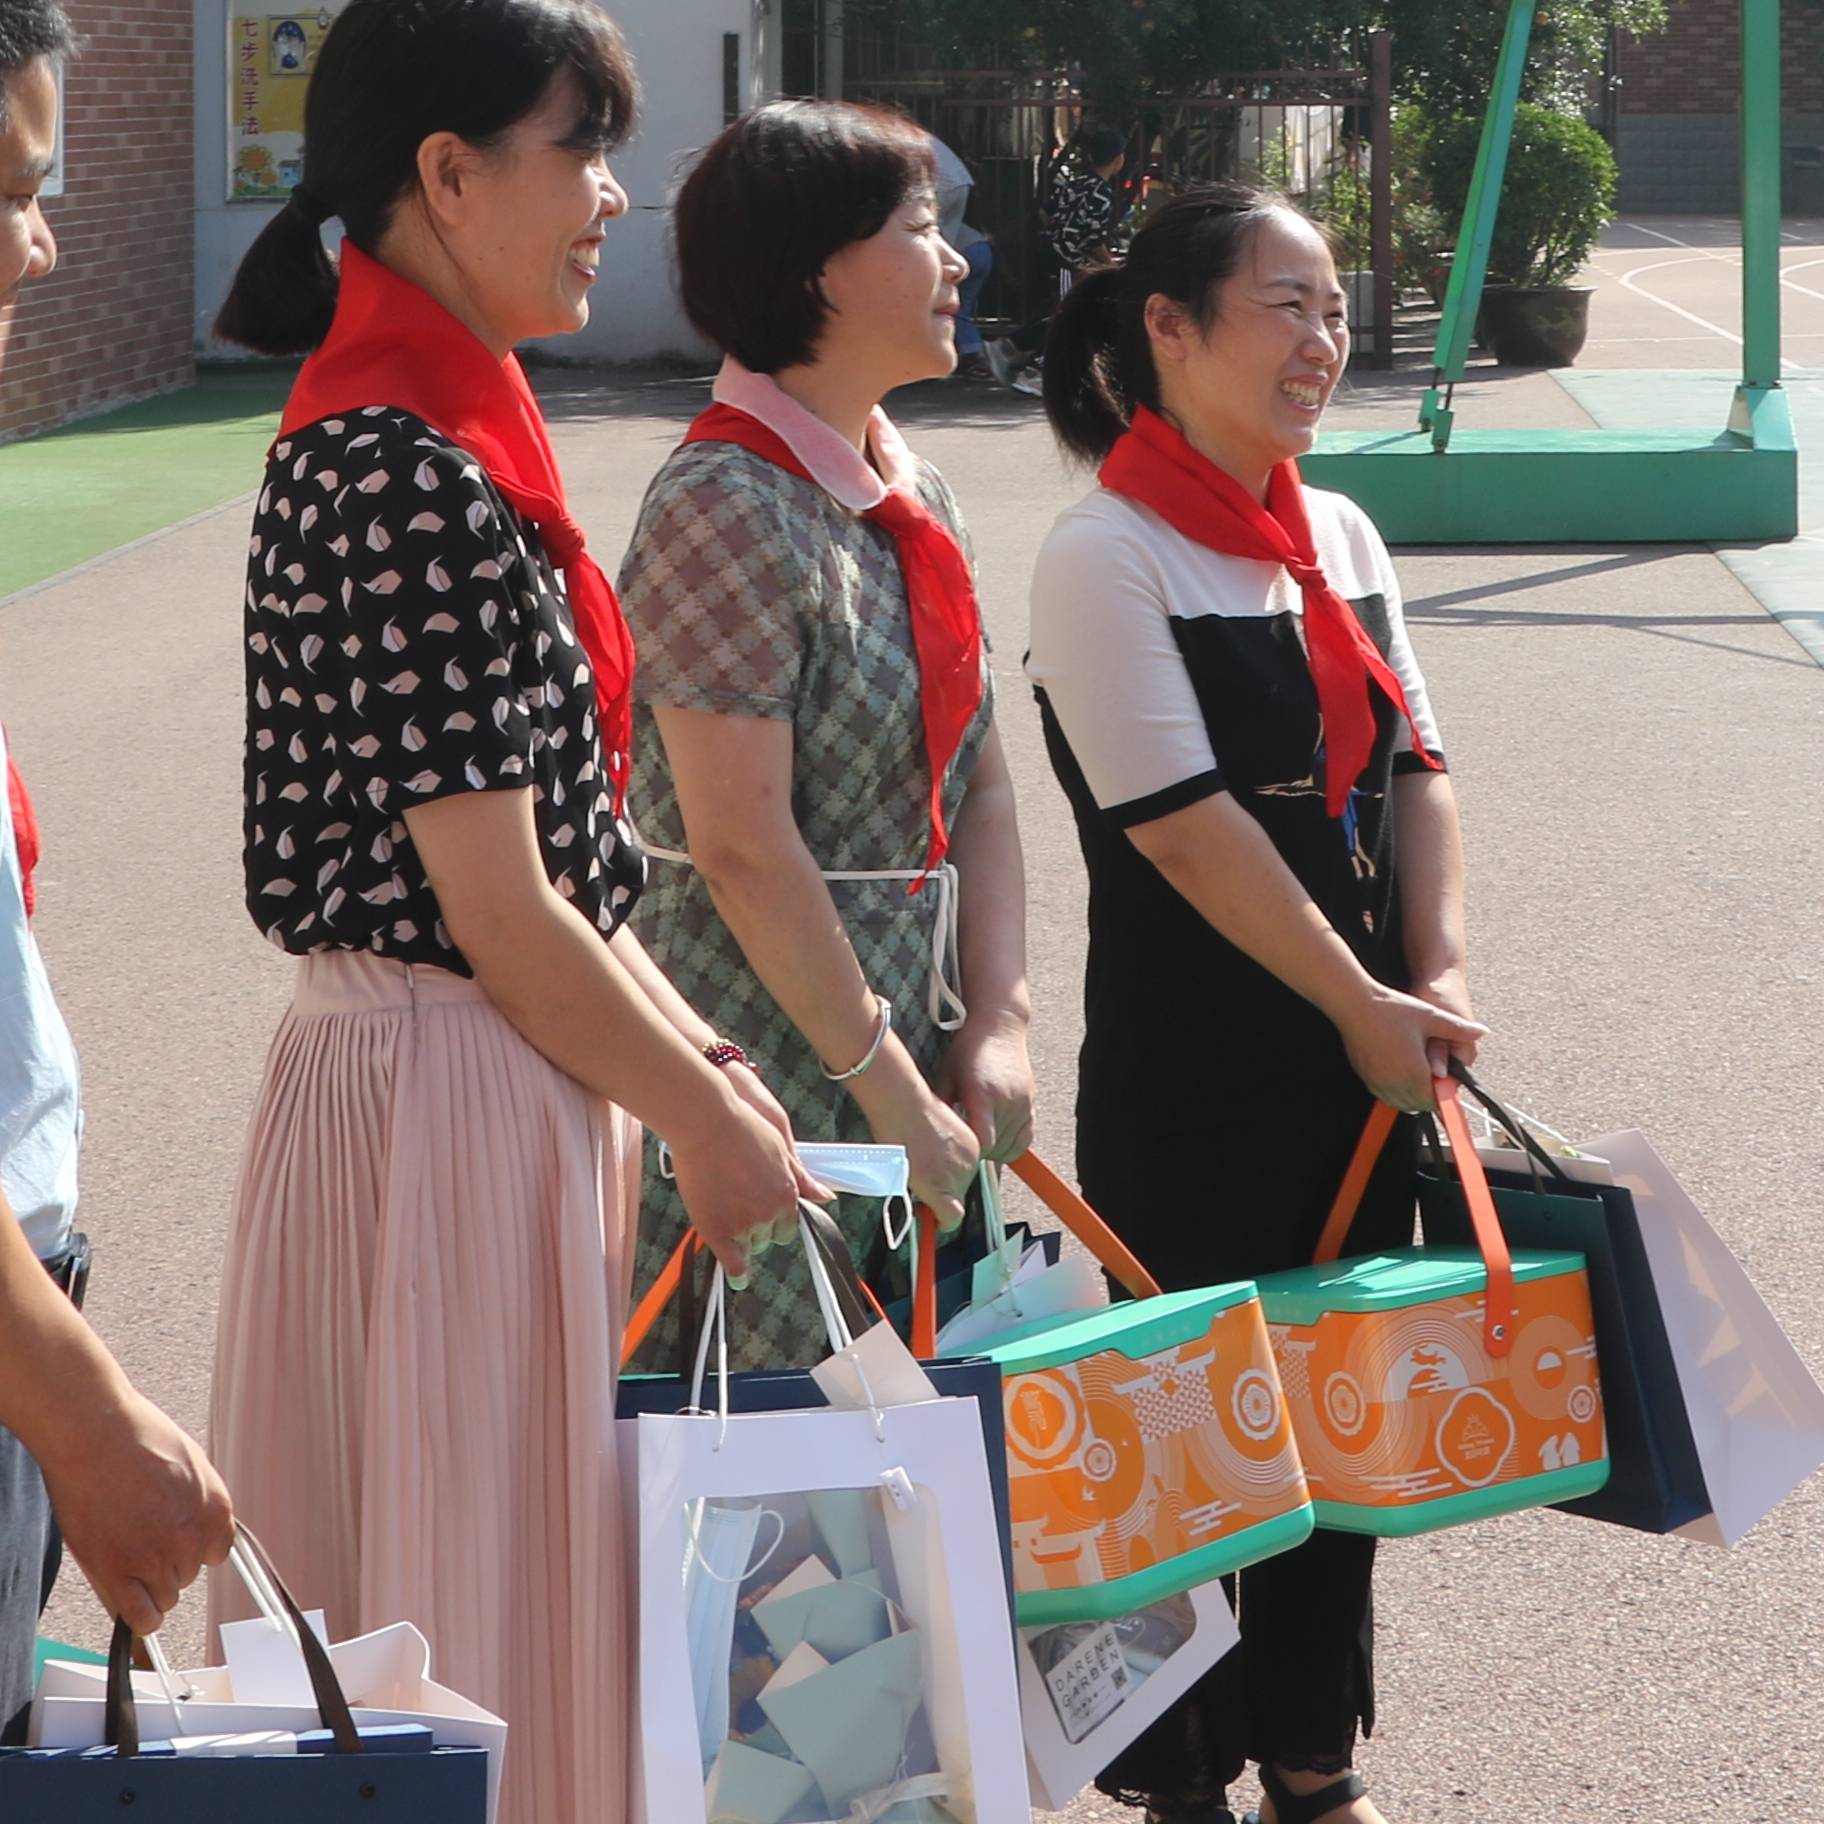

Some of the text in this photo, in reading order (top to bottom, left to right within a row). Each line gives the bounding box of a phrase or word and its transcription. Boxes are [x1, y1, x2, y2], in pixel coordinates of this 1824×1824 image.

[240, 19, 259, 136] 七步洗手法
